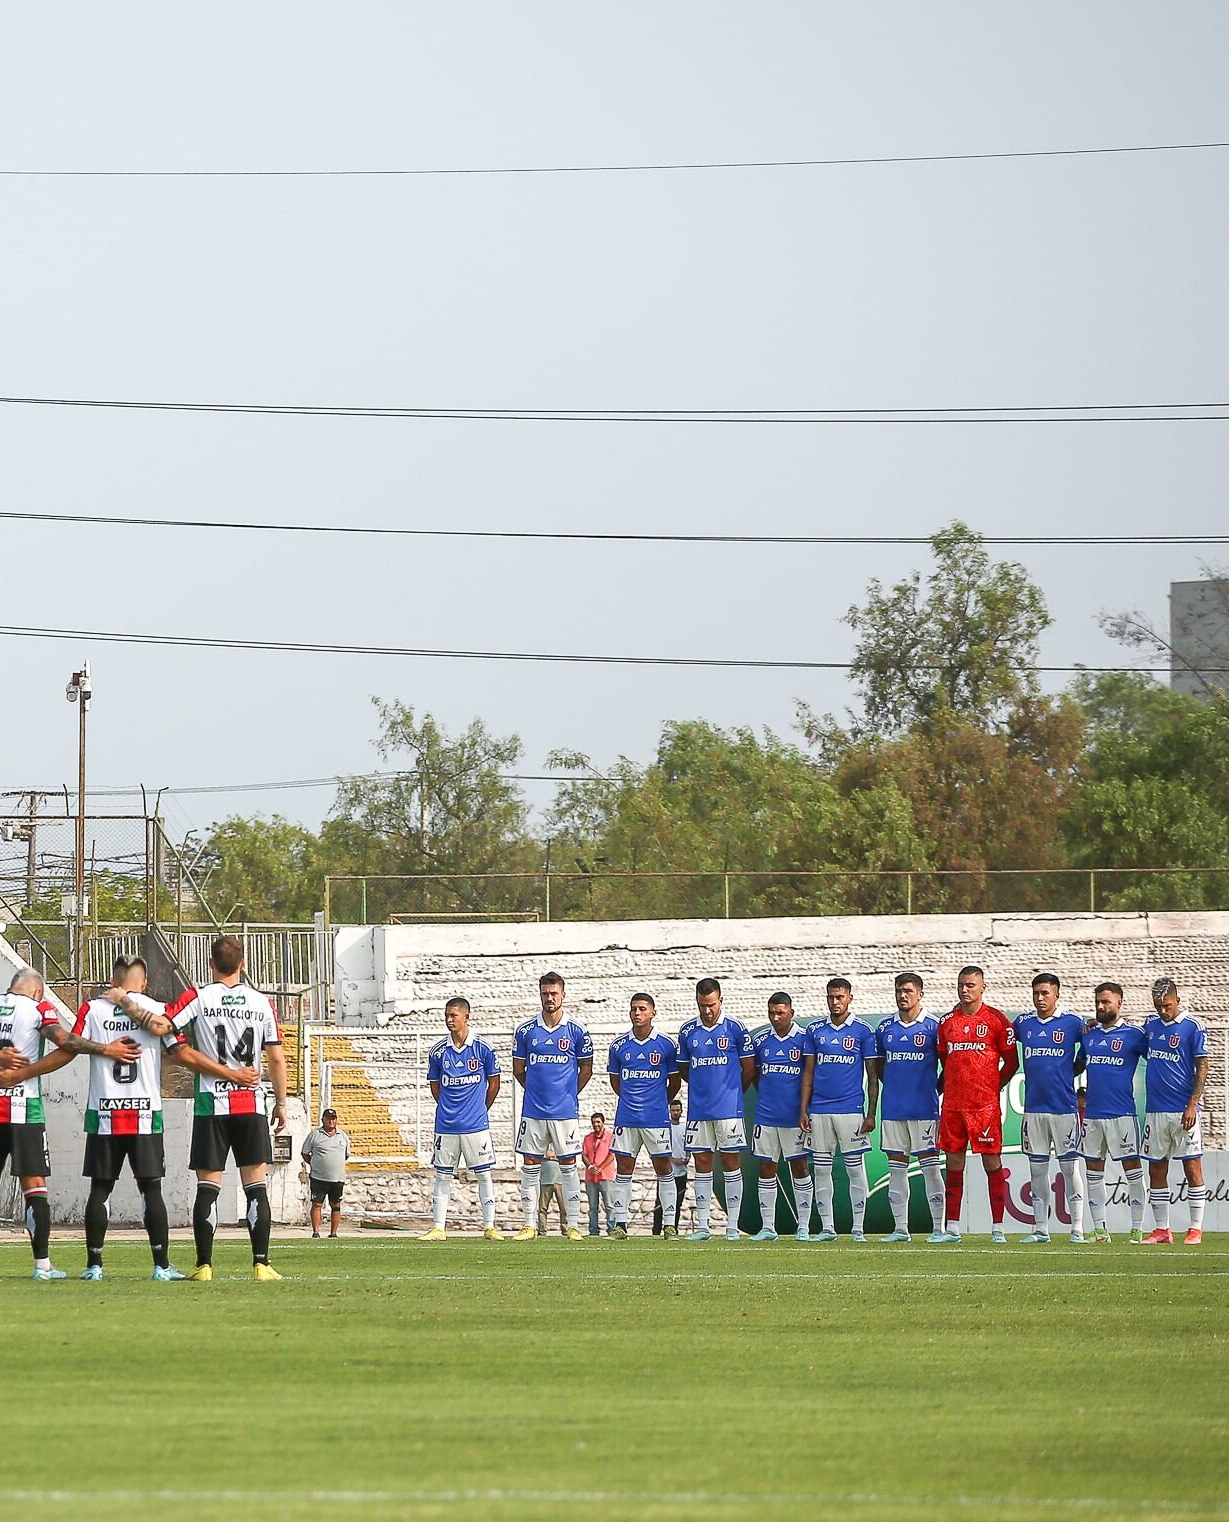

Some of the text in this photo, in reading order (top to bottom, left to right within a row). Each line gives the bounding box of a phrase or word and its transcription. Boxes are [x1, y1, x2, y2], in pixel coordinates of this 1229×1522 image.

[103, 1020, 140, 1031] CORNE
[215, 1024, 255, 1067] 14
[954, 1042, 986, 1051] BETANO
[892, 1052, 924, 1061] BETANO
[1032, 1048, 1064, 1057] BETANO
[1152, 1050, 1180, 1062] BETANO
[538, 1055, 568, 1064] BETANO
[698, 1056, 728, 1066] BETANO
[824, 1054, 854, 1064] BETANO
[1090, 1056, 1124, 1066] BETANO
[630, 1070, 660, 1078] BETANO
[769, 1065, 800, 1074] BETANO
[450, 1074, 480, 1086] BETANO
[100, 1099, 149, 1110] KAYSER
